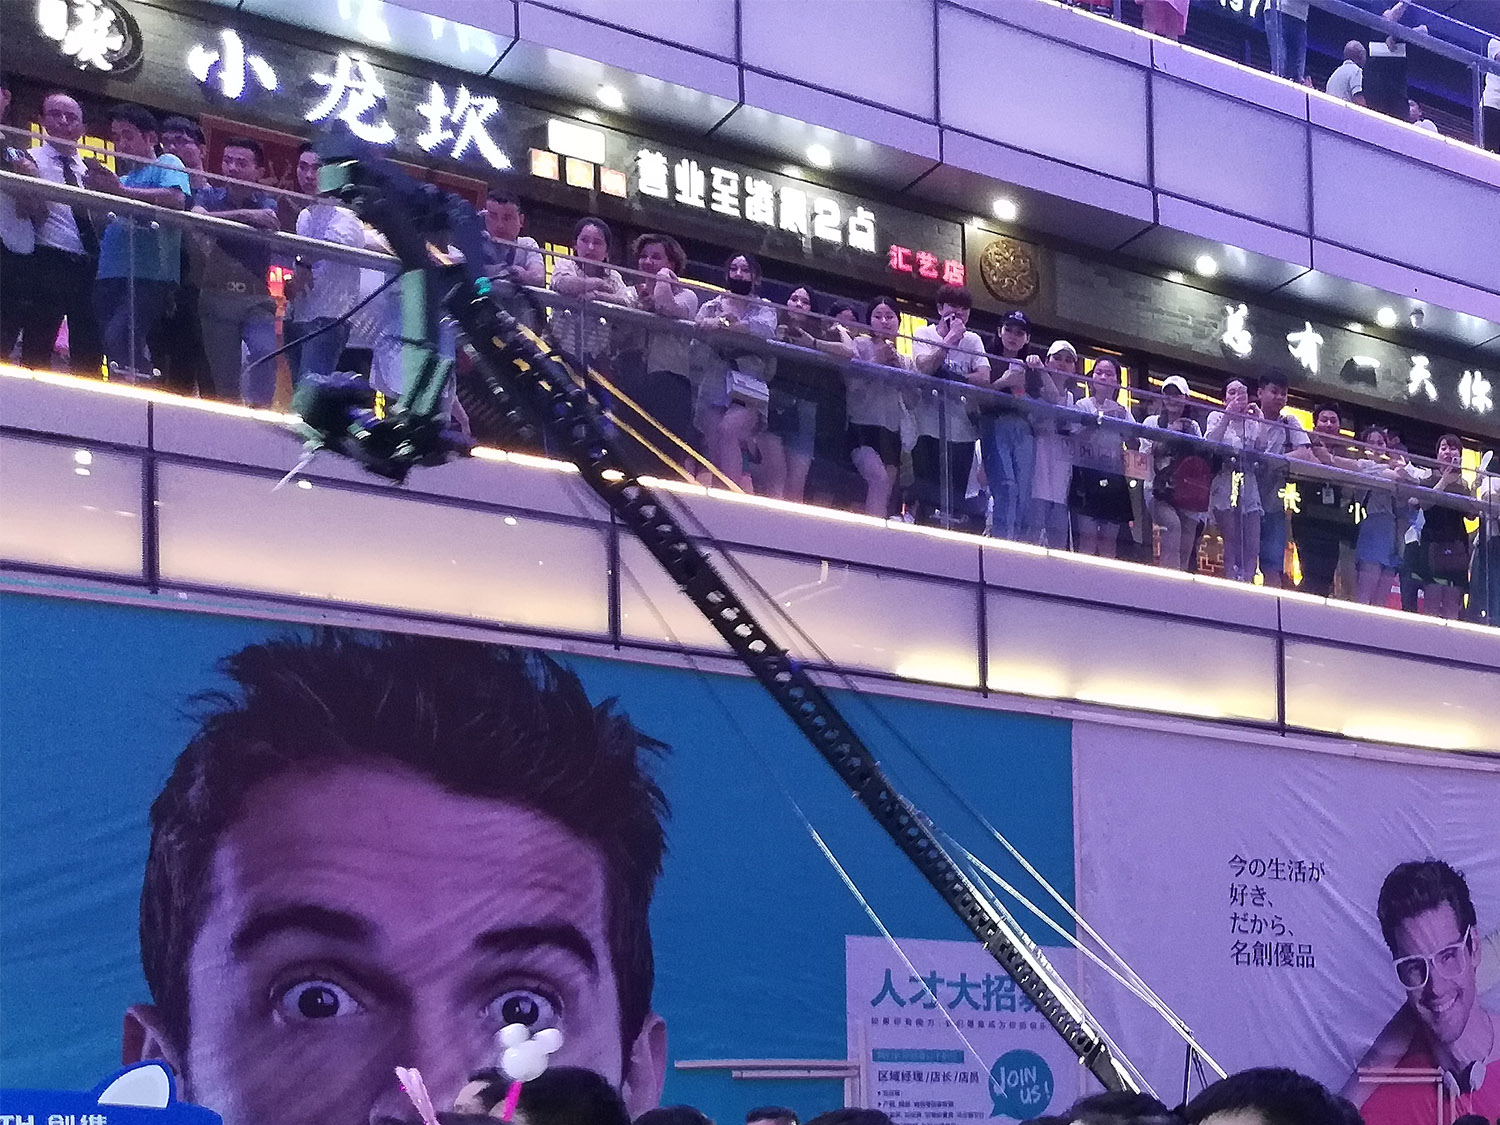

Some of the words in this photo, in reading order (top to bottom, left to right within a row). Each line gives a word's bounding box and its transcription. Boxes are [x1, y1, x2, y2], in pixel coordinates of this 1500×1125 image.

[187, 28, 514, 170] 小龙坎
[888, 243, 965, 287] 汇艺店
[1228, 854, 1326, 883] 今の生活が
[1230, 939, 1316, 969] 名創優品
[993, 1066, 1038, 1096] JOIN
